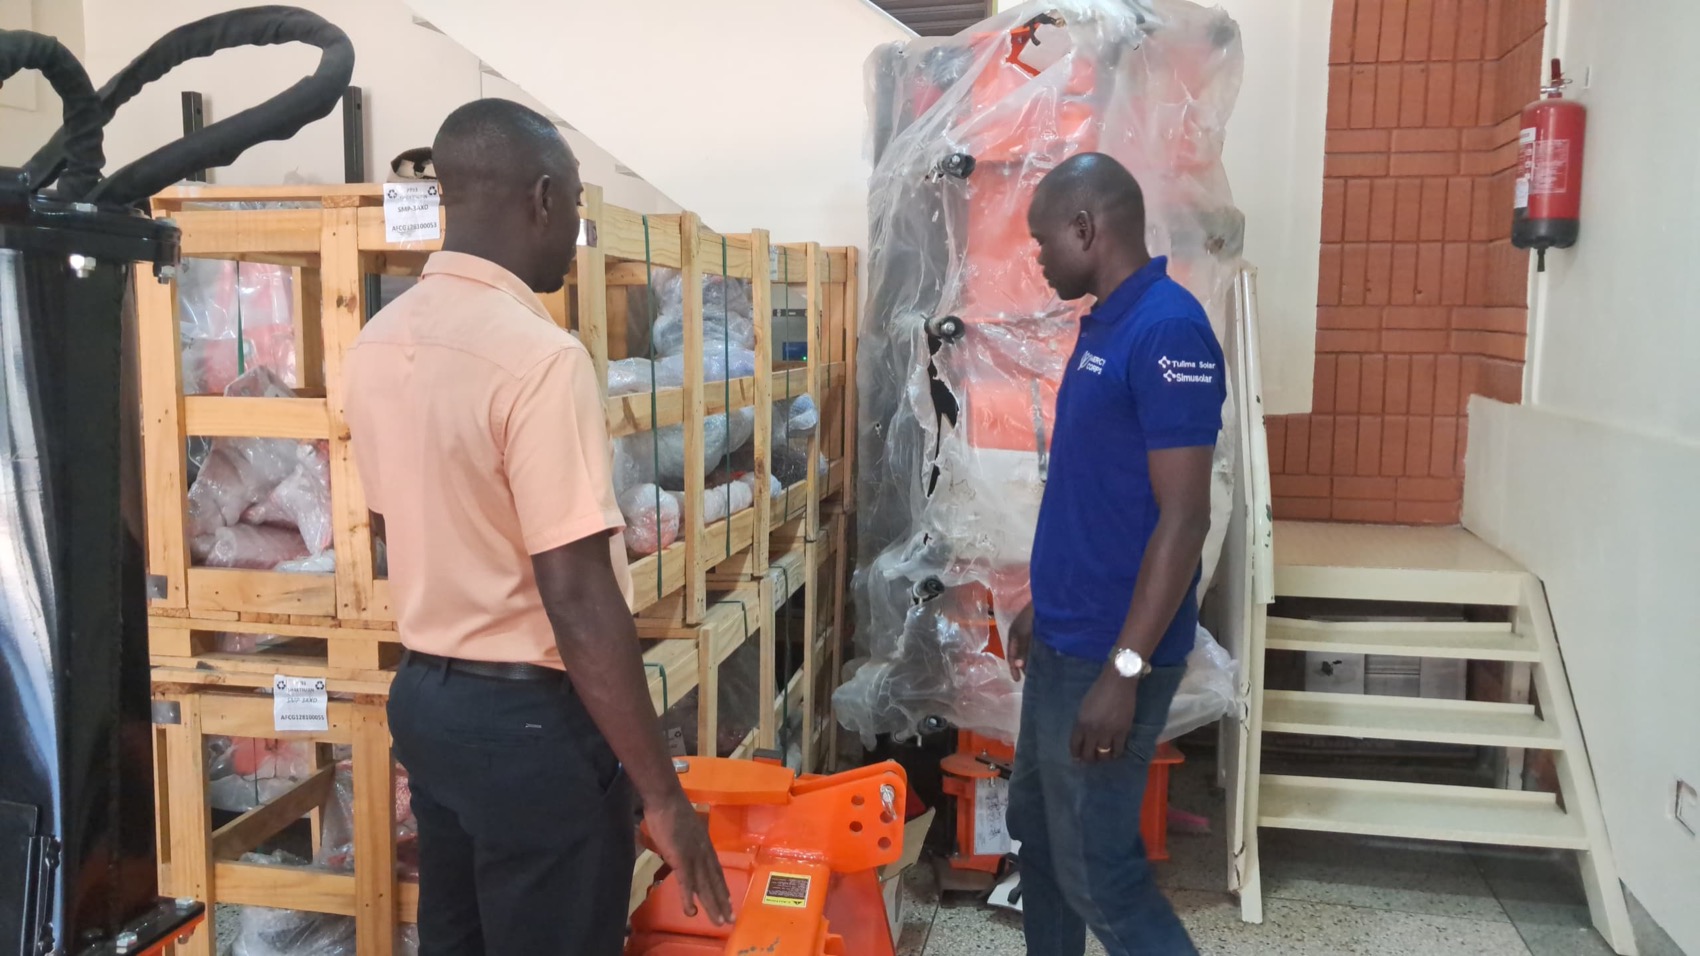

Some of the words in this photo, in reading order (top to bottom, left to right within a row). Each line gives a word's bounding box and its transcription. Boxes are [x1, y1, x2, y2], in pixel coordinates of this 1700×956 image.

[1171, 360, 1196, 368] Tulima
[1198, 360, 1216, 369] Solar
[1176, 373, 1213, 383] Simusolar
